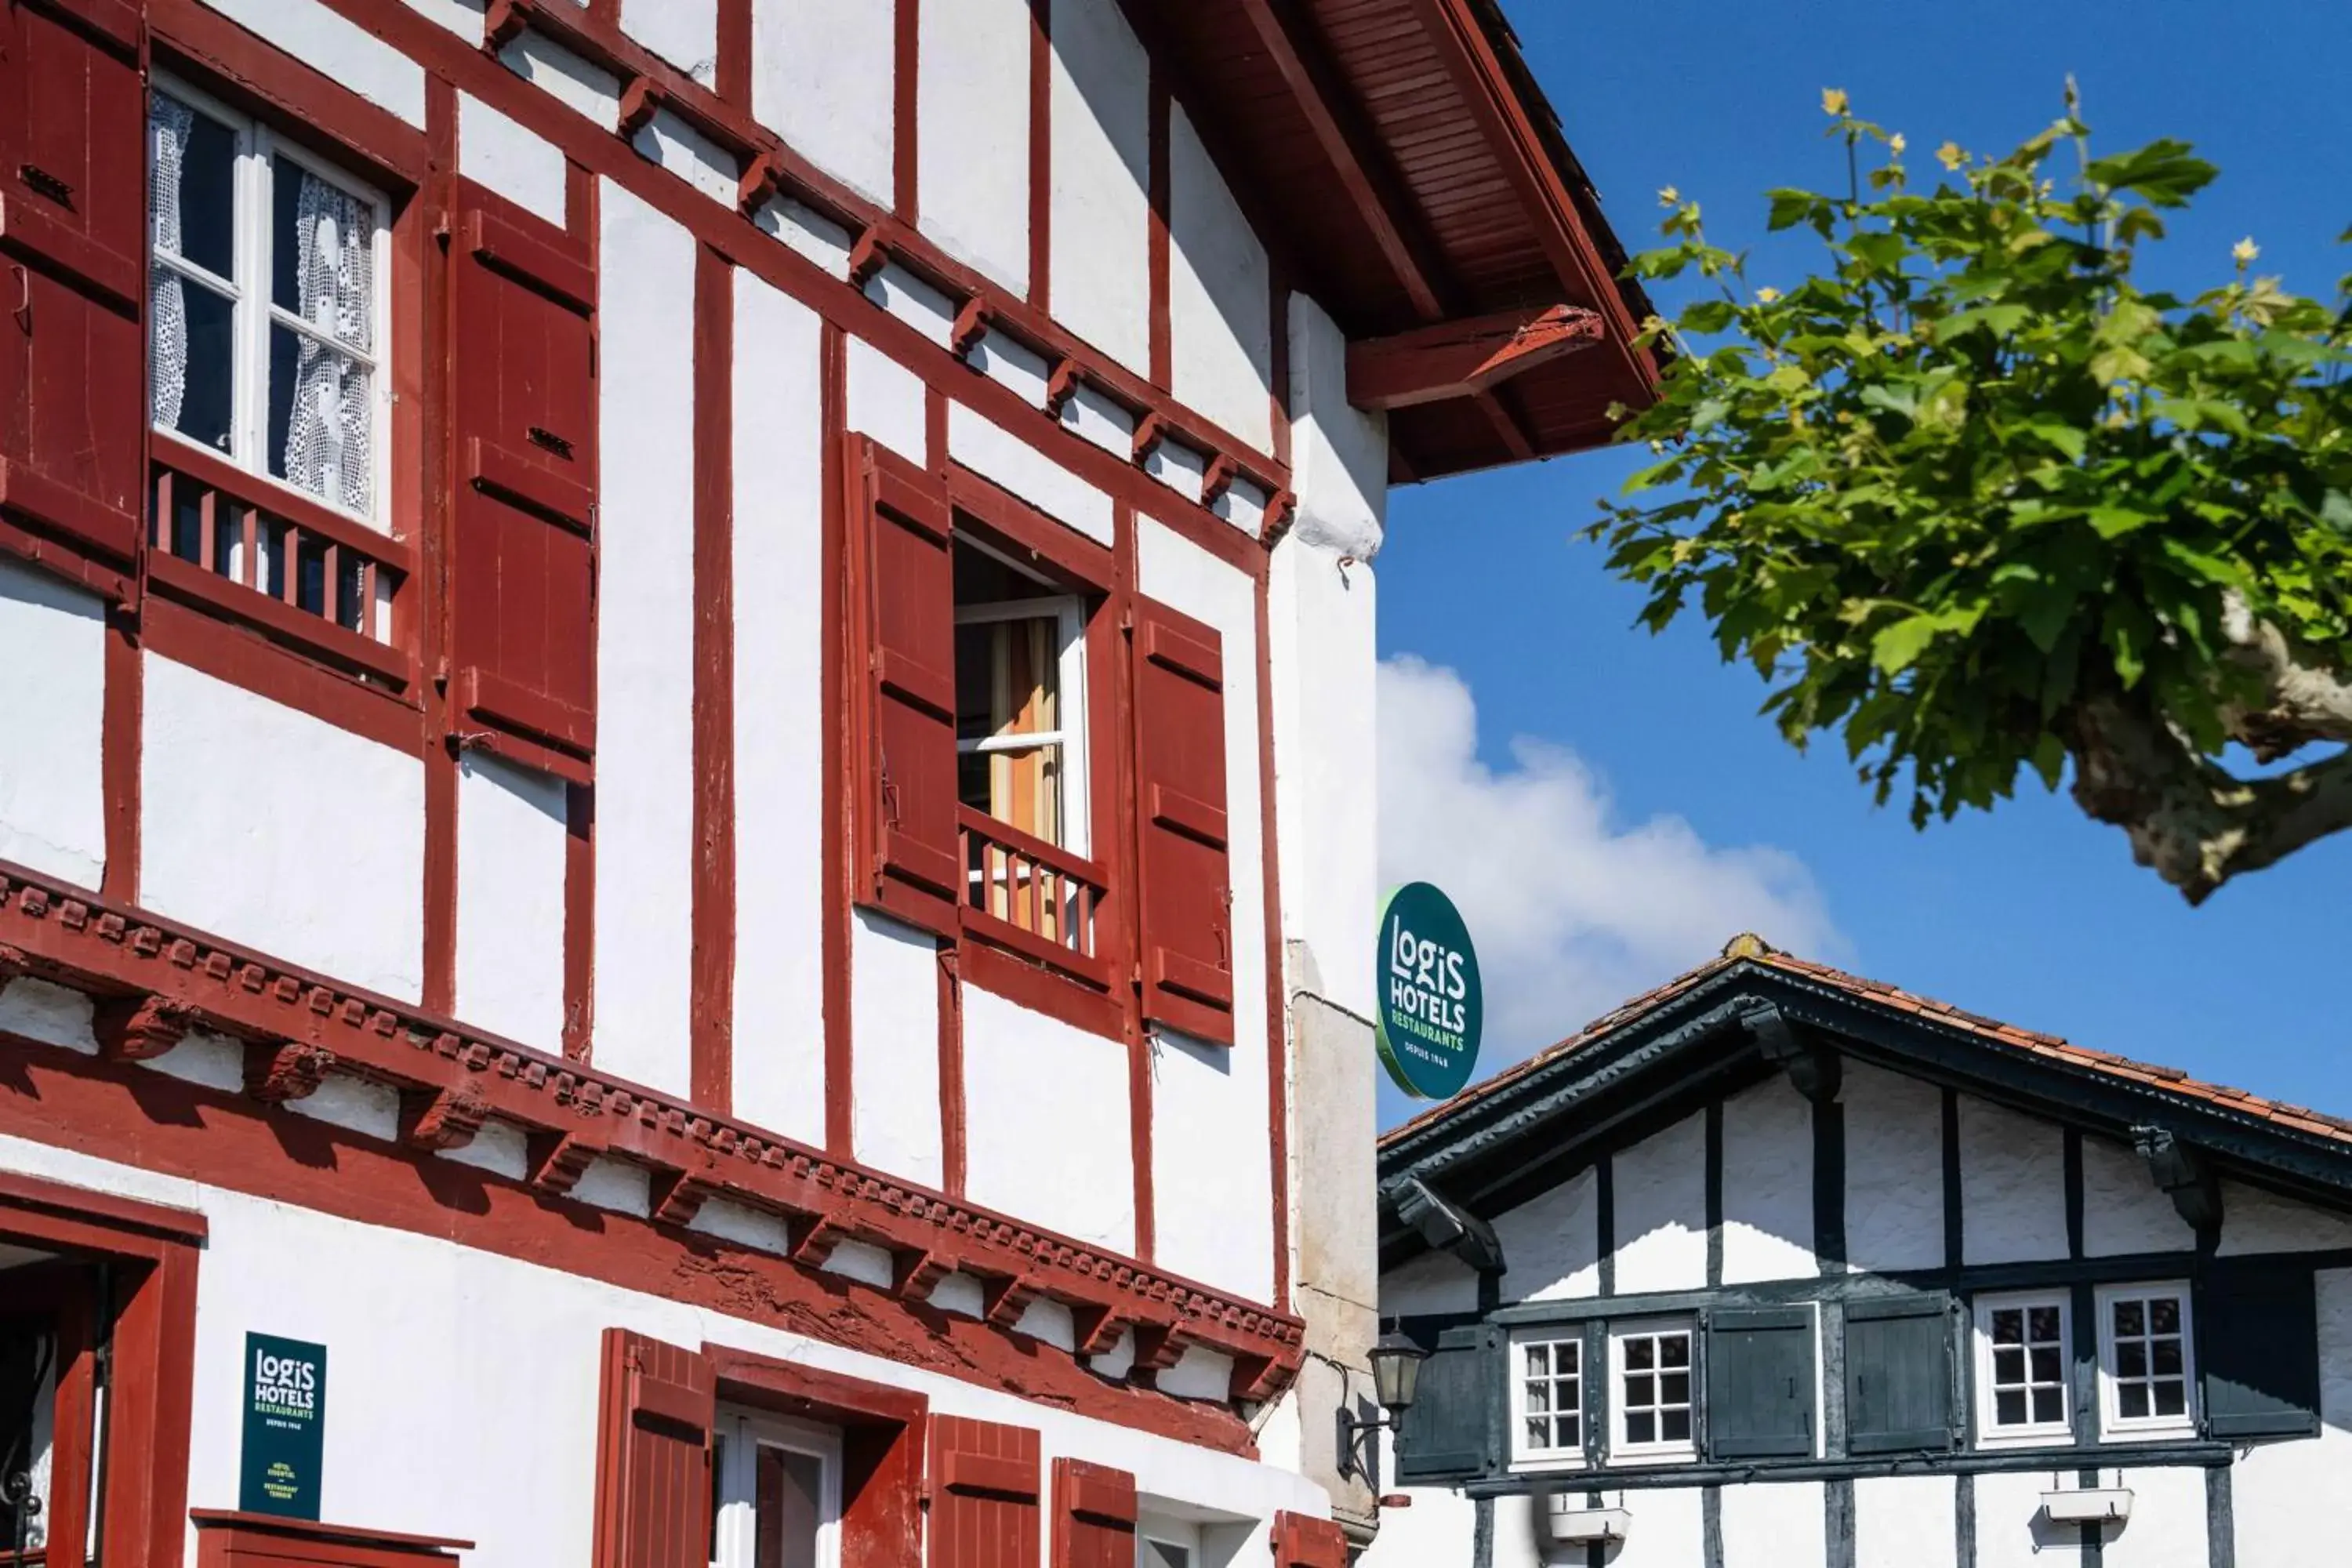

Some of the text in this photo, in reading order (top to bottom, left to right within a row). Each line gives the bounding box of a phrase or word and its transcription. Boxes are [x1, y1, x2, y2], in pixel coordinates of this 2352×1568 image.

[1391, 977, 1465, 1033] HOTELS
[1392, 1008, 1464, 1052] RESTAURANTS
[1404, 1041, 1429, 1061] DEPUIS
[255, 1384, 314, 1409] HOTELS
[255, 1402, 314, 1421] RESTAURANTS
